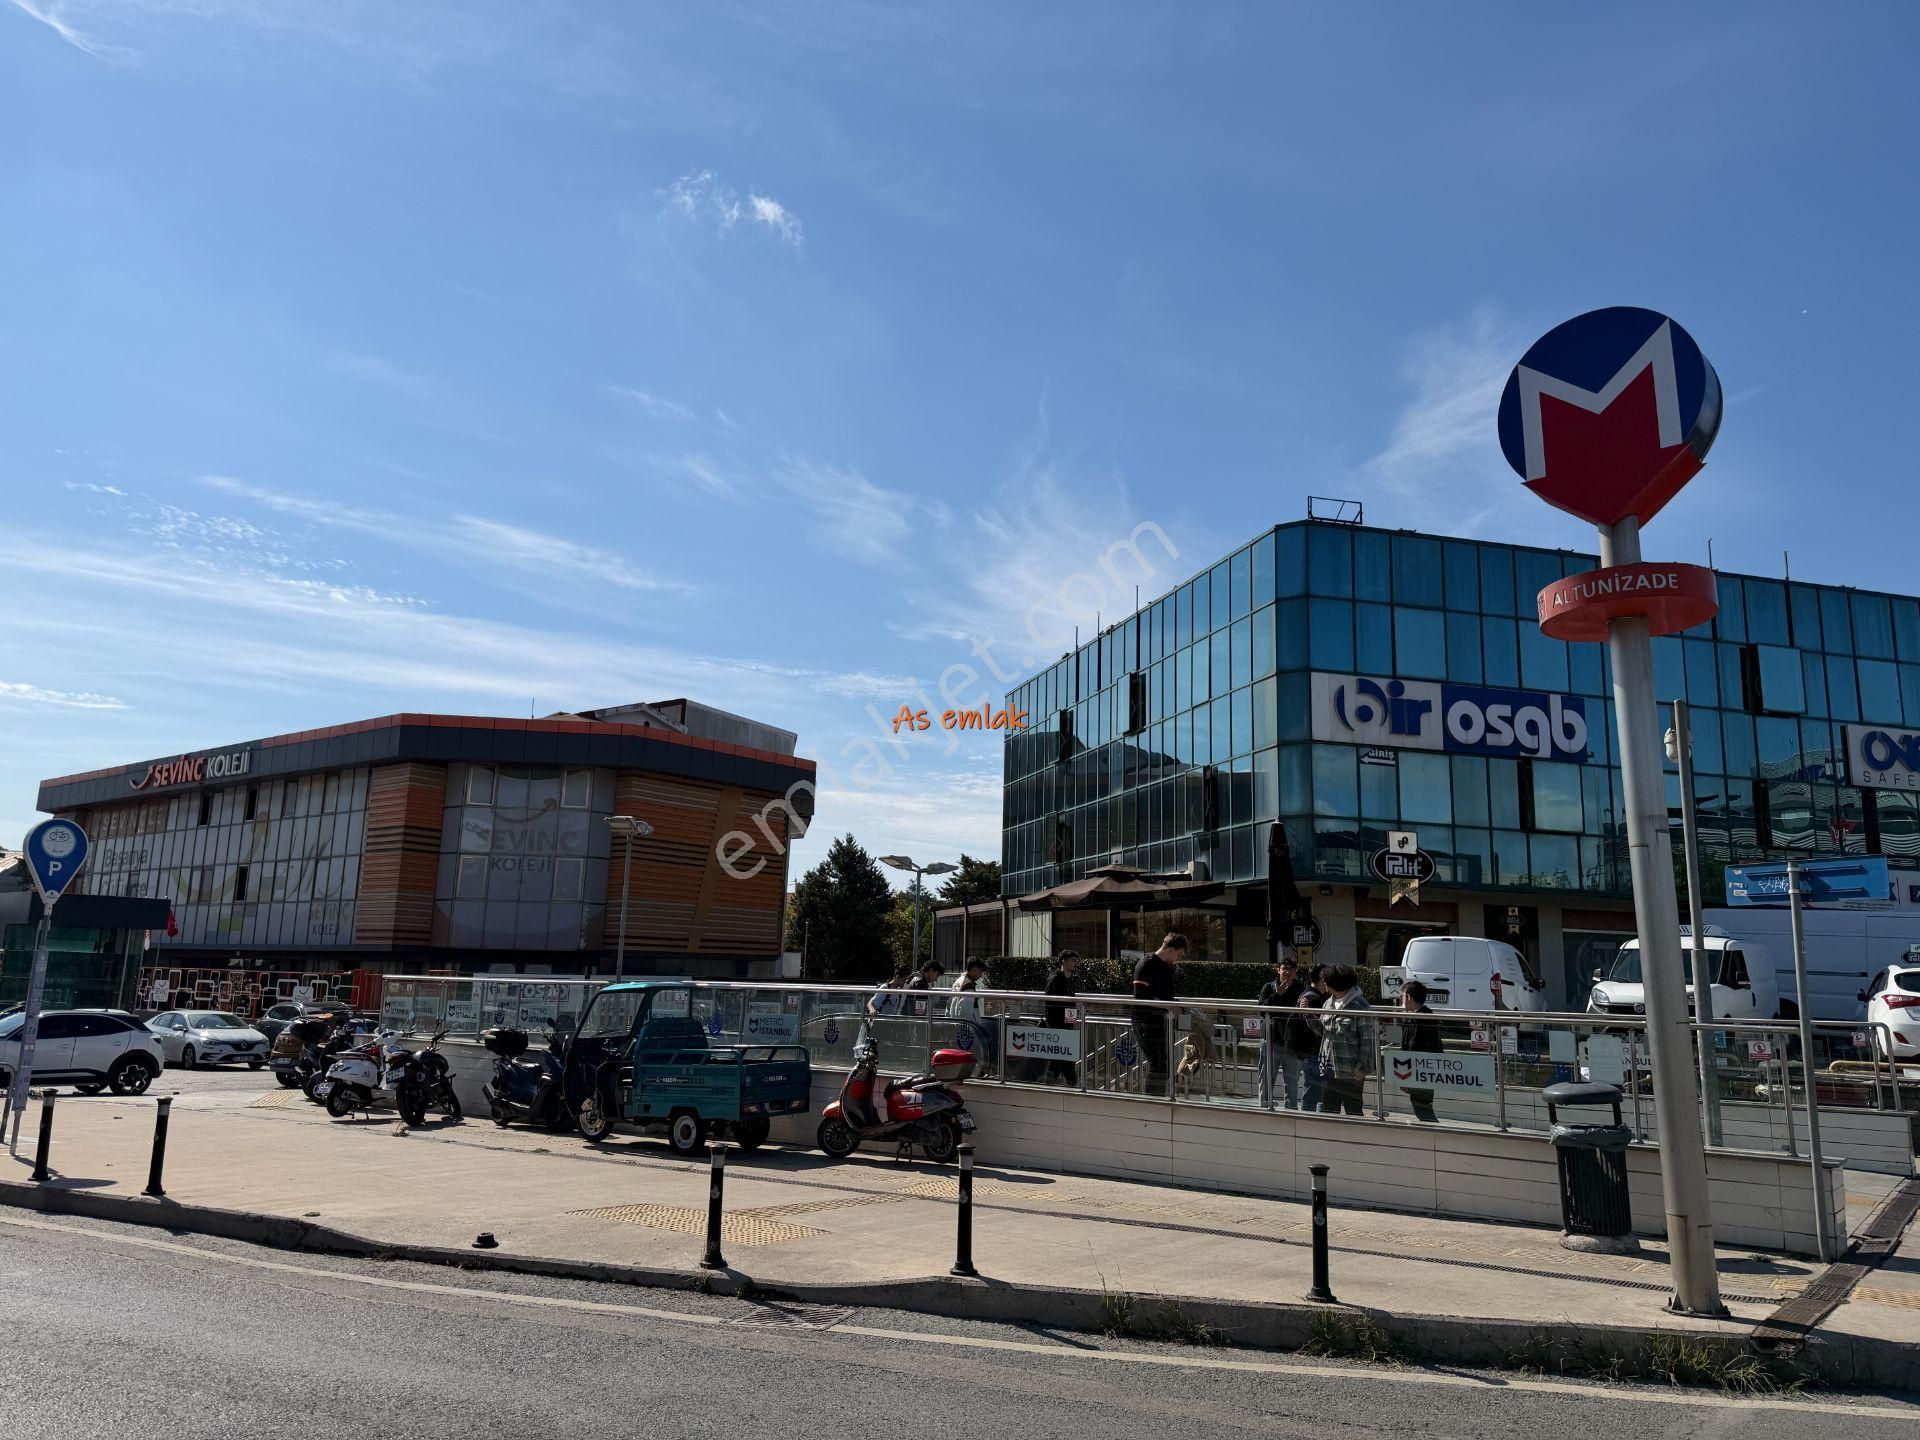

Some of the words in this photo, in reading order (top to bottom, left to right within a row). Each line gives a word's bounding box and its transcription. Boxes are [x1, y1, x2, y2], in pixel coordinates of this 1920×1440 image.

[1553, 573, 1679, 609] ALTUNİZADE
[1334, 678, 1432, 736] bir
[1447, 693, 1588, 758] osgb
[152, 754, 206, 788] SEVİNÇ
[206, 747, 251, 779] KOLEJİ
[48, 860, 63, 877] P
[760, 1018, 784, 1026] METRO
[759, 1026, 792, 1037] İSTANBUL
[1027, 1033, 1060, 1042] METRO
[1027, 1042, 1073, 1056] İSTANBUL
[1415, 1058, 1463, 1071] METRO
[1415, 1070, 1484, 1087] İSTANBUL
